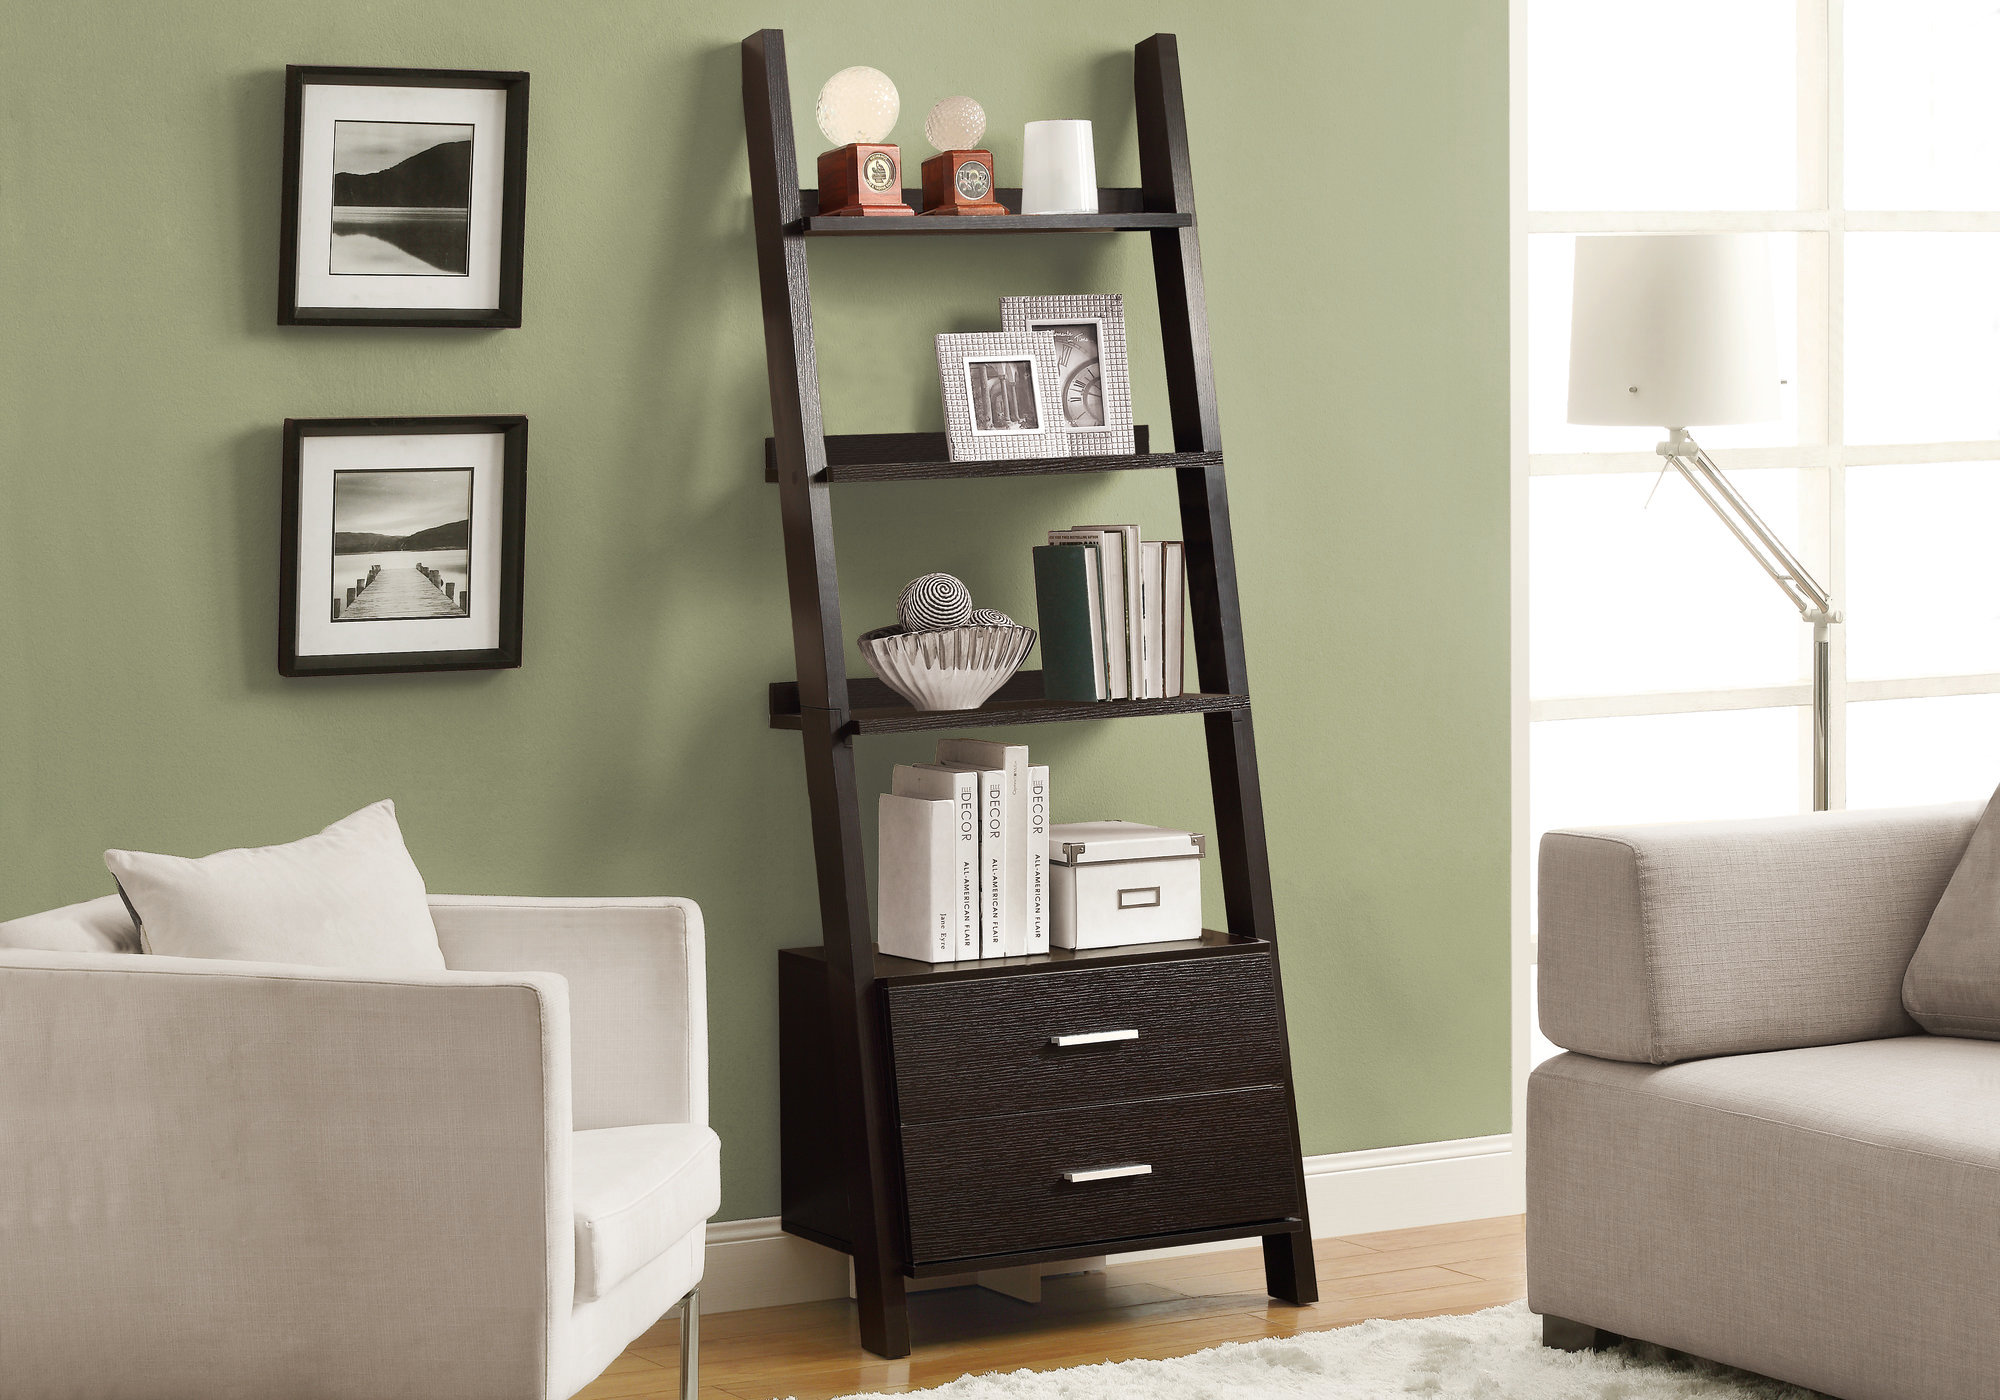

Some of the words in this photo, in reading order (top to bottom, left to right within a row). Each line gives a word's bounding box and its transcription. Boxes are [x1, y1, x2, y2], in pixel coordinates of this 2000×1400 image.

[960, 792, 972, 841] DECOR
[989, 790, 1001, 839] DECOR
[1032, 786, 1043, 834] DECOR
[939, 913, 947, 930] Jane
[939, 932, 947, 950] Eyre
